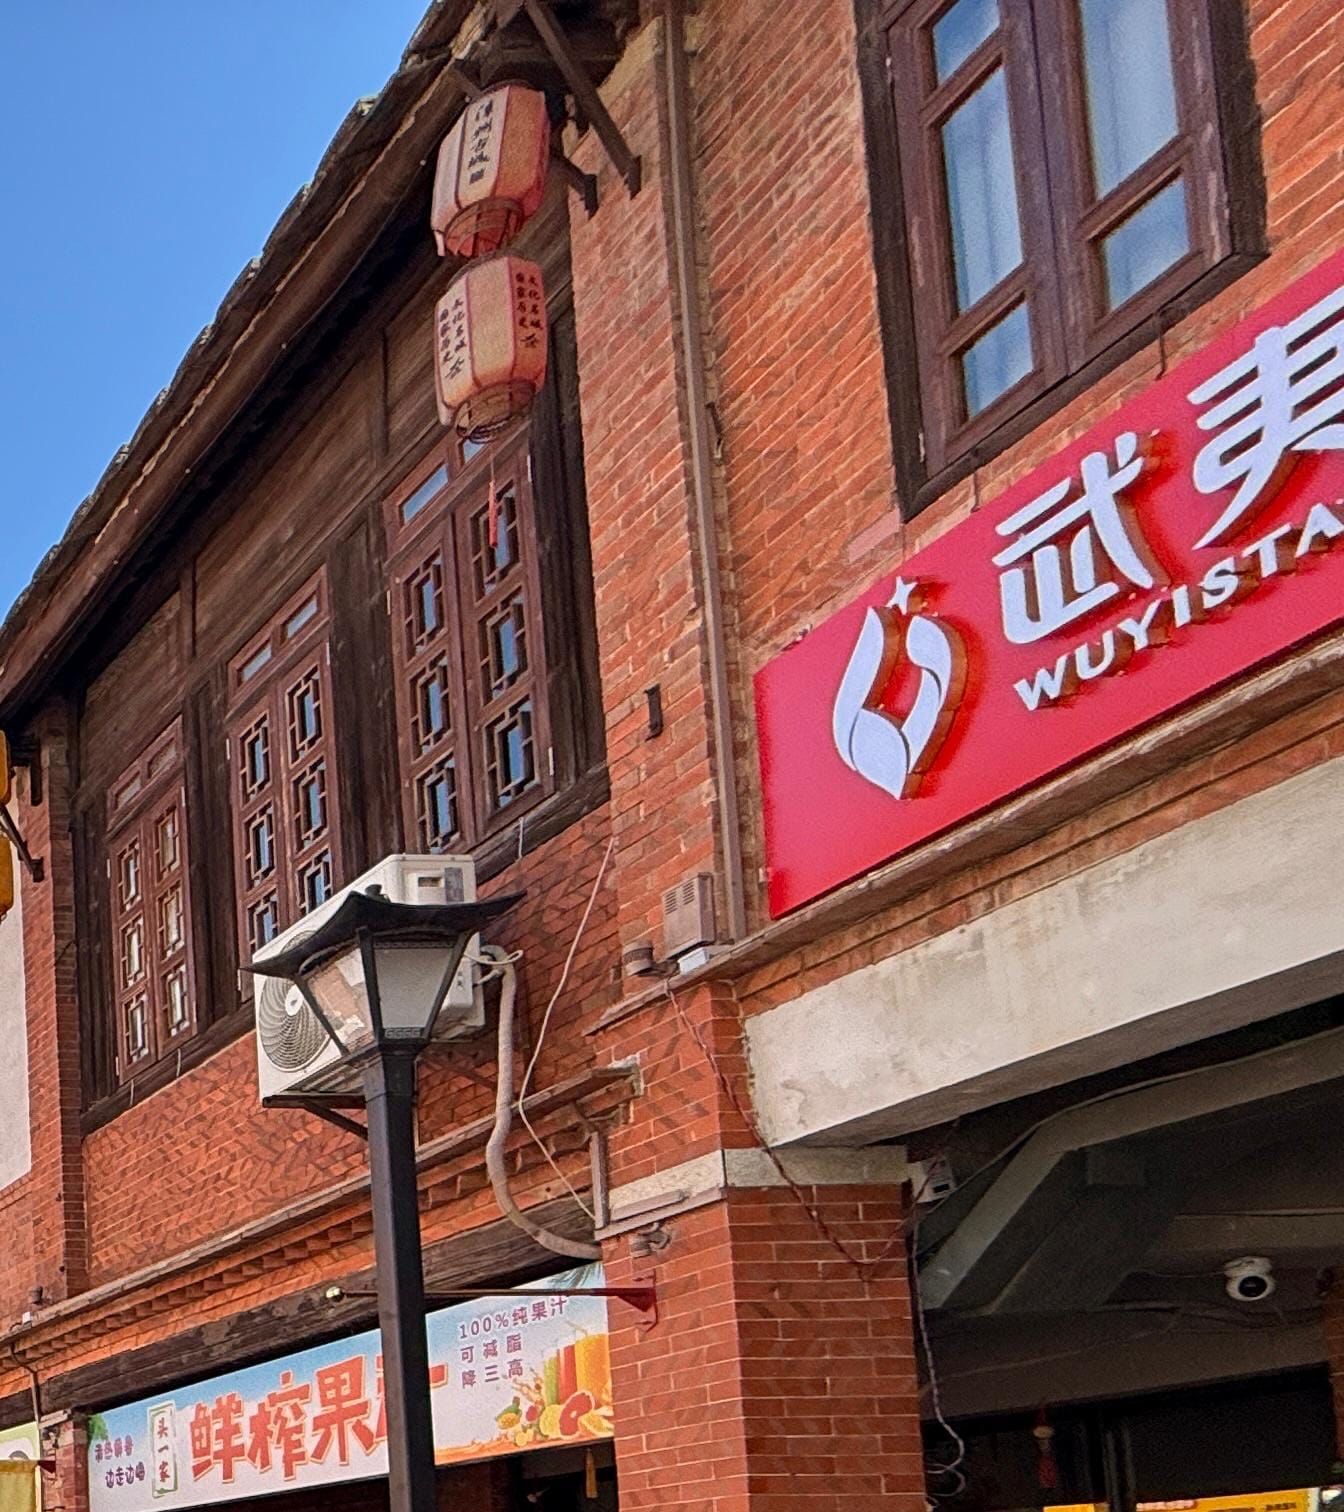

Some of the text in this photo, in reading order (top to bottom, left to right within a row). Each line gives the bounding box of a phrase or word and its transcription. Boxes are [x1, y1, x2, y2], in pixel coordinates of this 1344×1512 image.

[459, 1295, 568, 1340] 100%纯果汁
[462, 1358, 524, 1389] 降三高
[188, 1353, 449, 1484] 鲜榨果
[156, 1418, 171, 1484] 头一家
